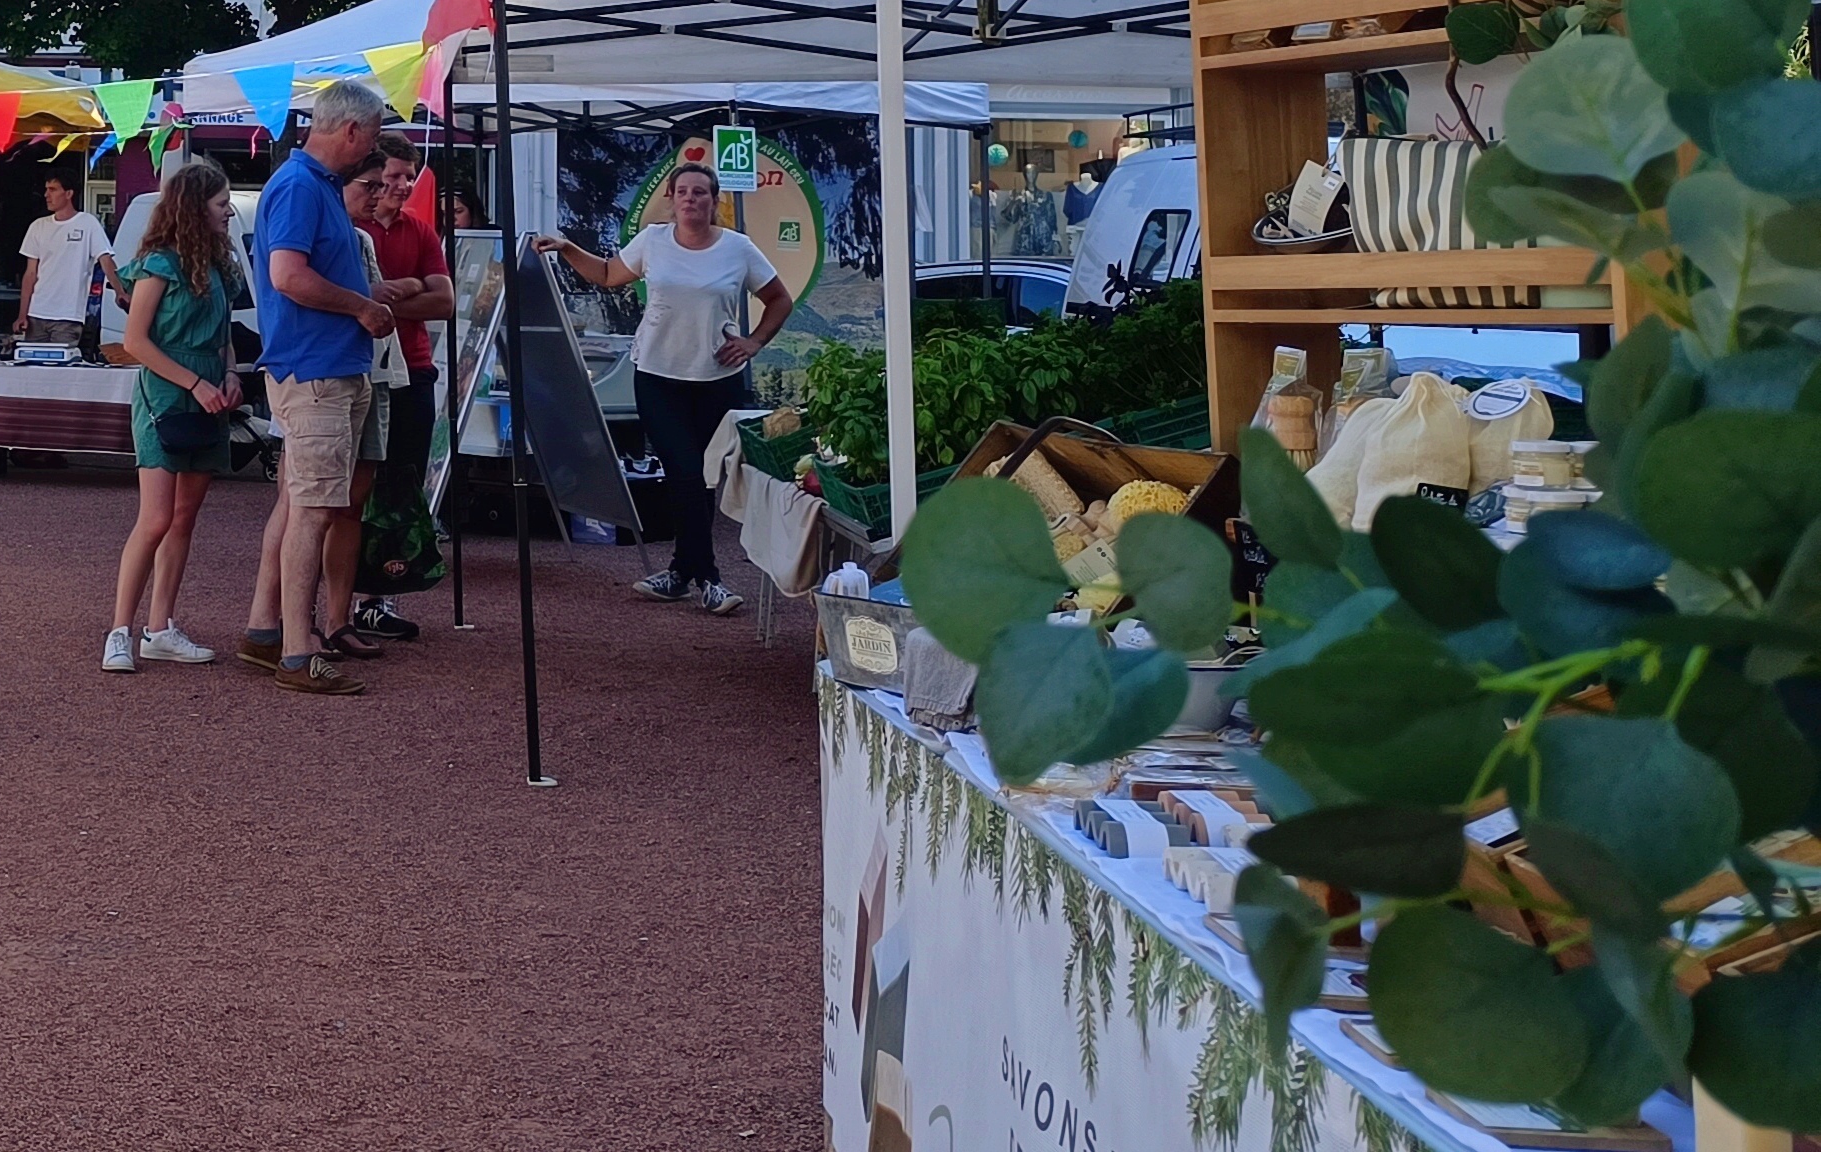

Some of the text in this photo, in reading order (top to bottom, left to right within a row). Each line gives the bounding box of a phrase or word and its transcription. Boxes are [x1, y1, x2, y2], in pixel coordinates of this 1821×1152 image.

[720, 142, 750, 170] AB
[759, 144, 772, 156] AU
[774, 152, 793, 170] LAIT
[789, 168, 805, 185] CRU
[779, 228, 798, 242] AB
[851, 637, 892, 654] JARDIN
